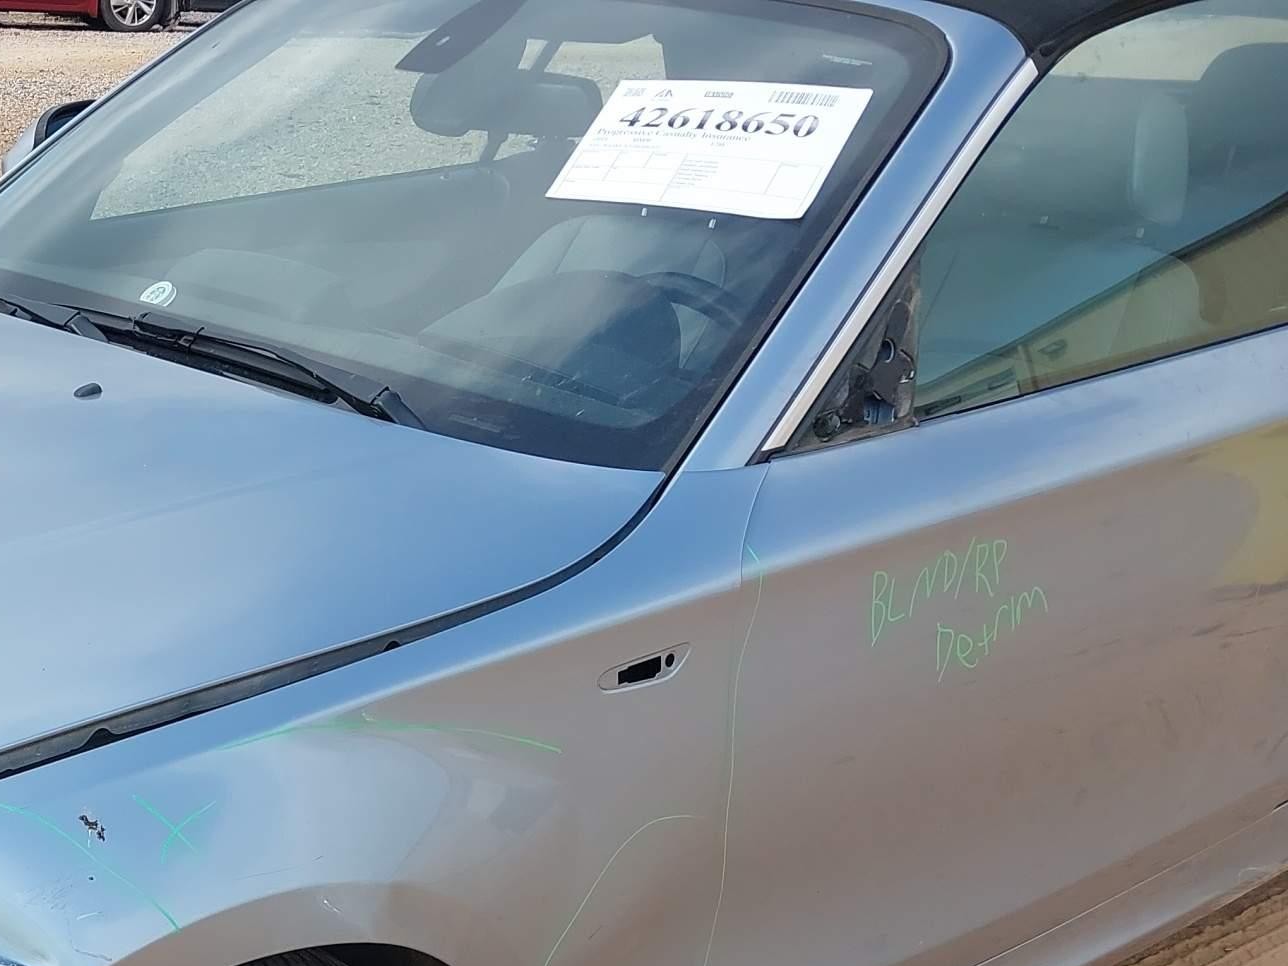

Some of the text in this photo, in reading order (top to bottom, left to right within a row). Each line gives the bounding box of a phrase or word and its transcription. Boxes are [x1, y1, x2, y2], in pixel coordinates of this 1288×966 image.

[619, 105, 820, 138] 42618650
[597, 127, 654, 137] Progressive
[656, 130, 698, 140] Casualty
[701, 131, 752, 143] Insurance
